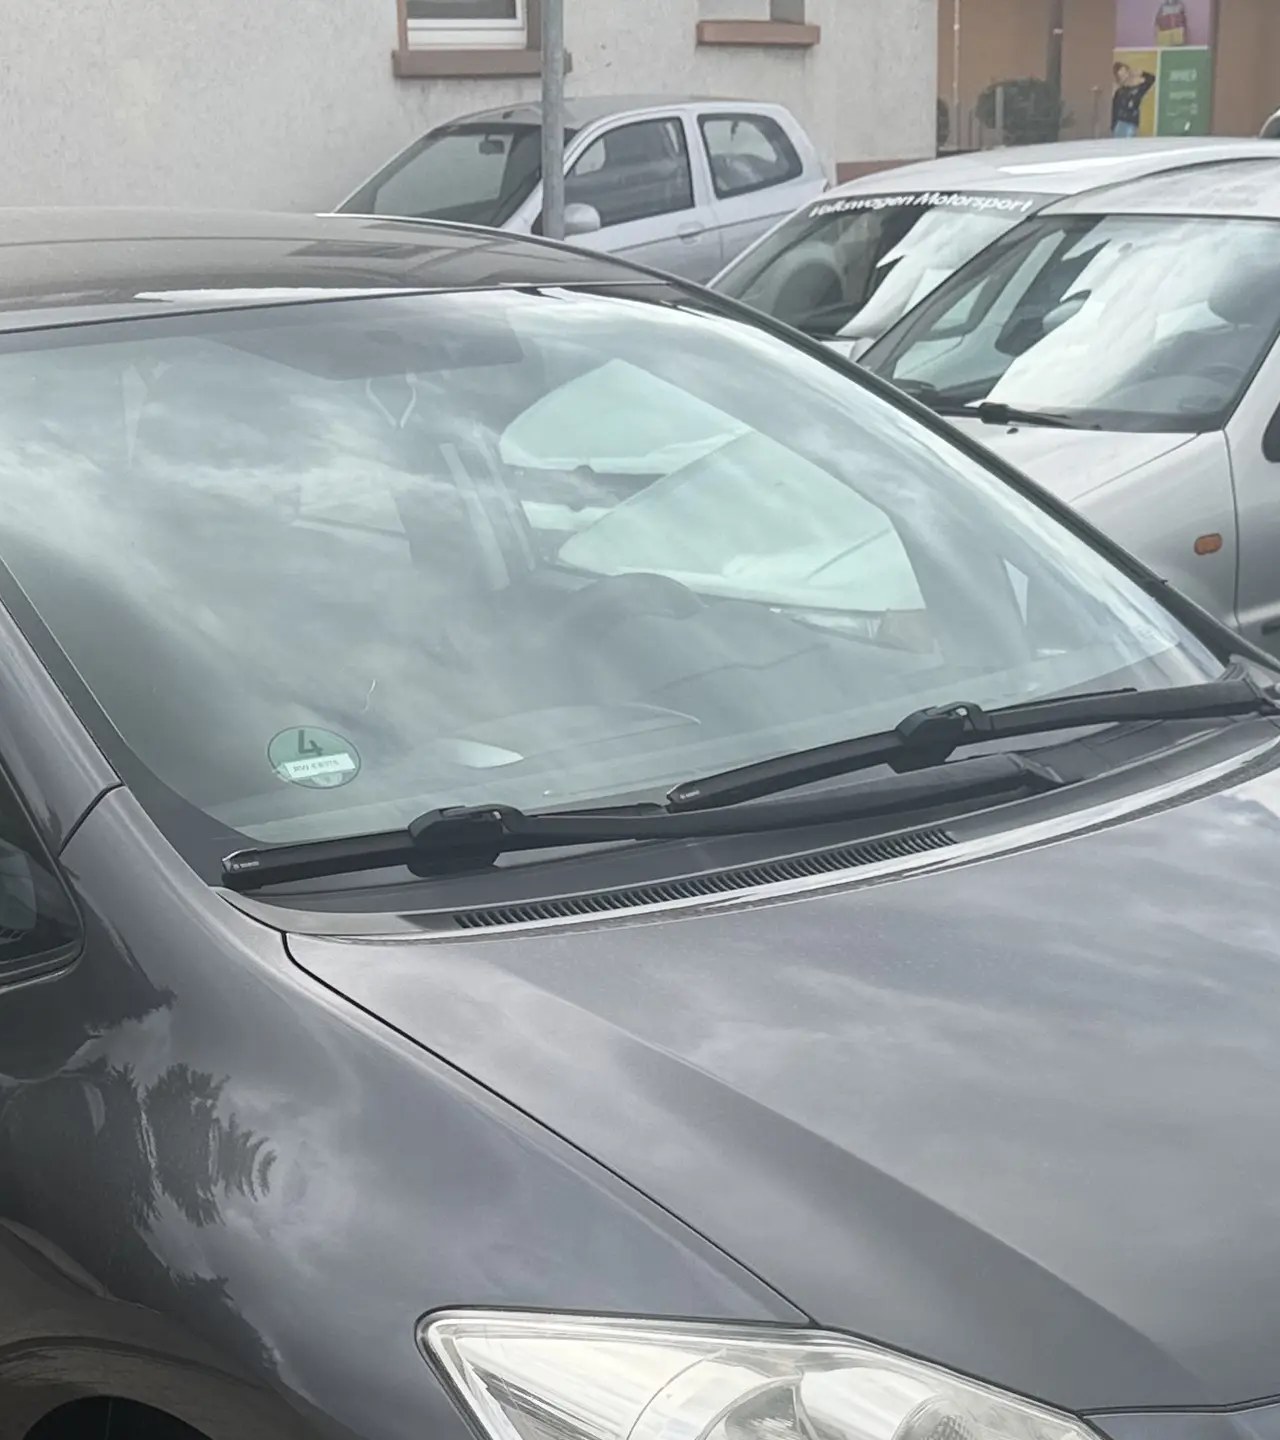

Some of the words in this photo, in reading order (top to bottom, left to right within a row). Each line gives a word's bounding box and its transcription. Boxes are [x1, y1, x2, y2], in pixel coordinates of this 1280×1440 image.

[808, 193, 915, 218] Volkswagen
[914, 191, 1034, 213] Motorsport
[297, 729, 324, 756] 4
